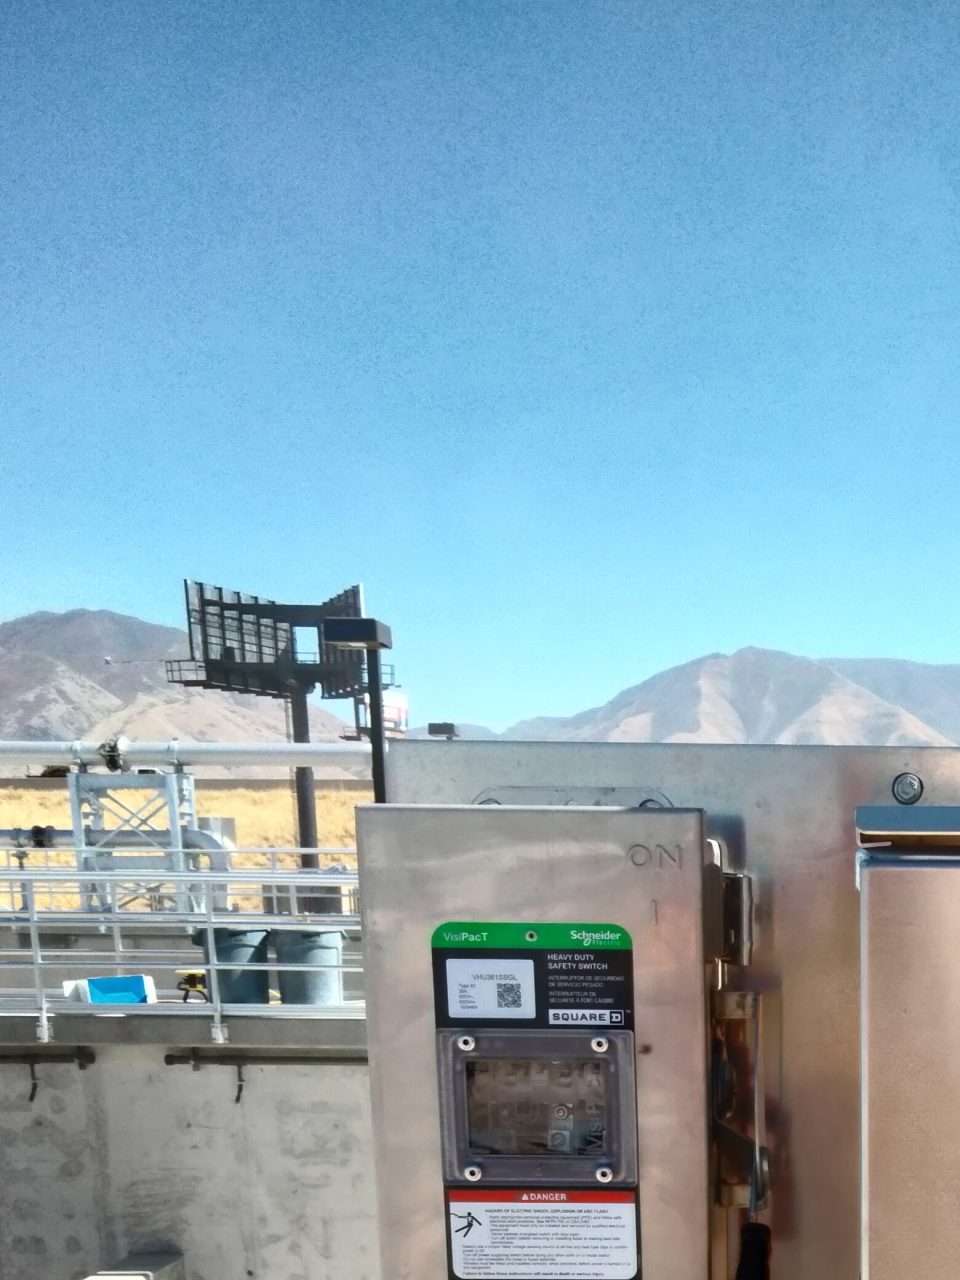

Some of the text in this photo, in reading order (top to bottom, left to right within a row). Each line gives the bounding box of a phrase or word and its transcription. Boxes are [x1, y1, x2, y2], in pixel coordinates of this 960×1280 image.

[625, 843, 683, 870] ON
[443, 932, 488, 942] VisiPacT
[570, 930, 621, 946] Schneider
[547, 953, 573, 961] HEAVY
[547, 962, 577, 970] SAFETY
[552, 1012, 622, 1022] SQUARE D
[530, 1193, 567, 1201] DANGER
